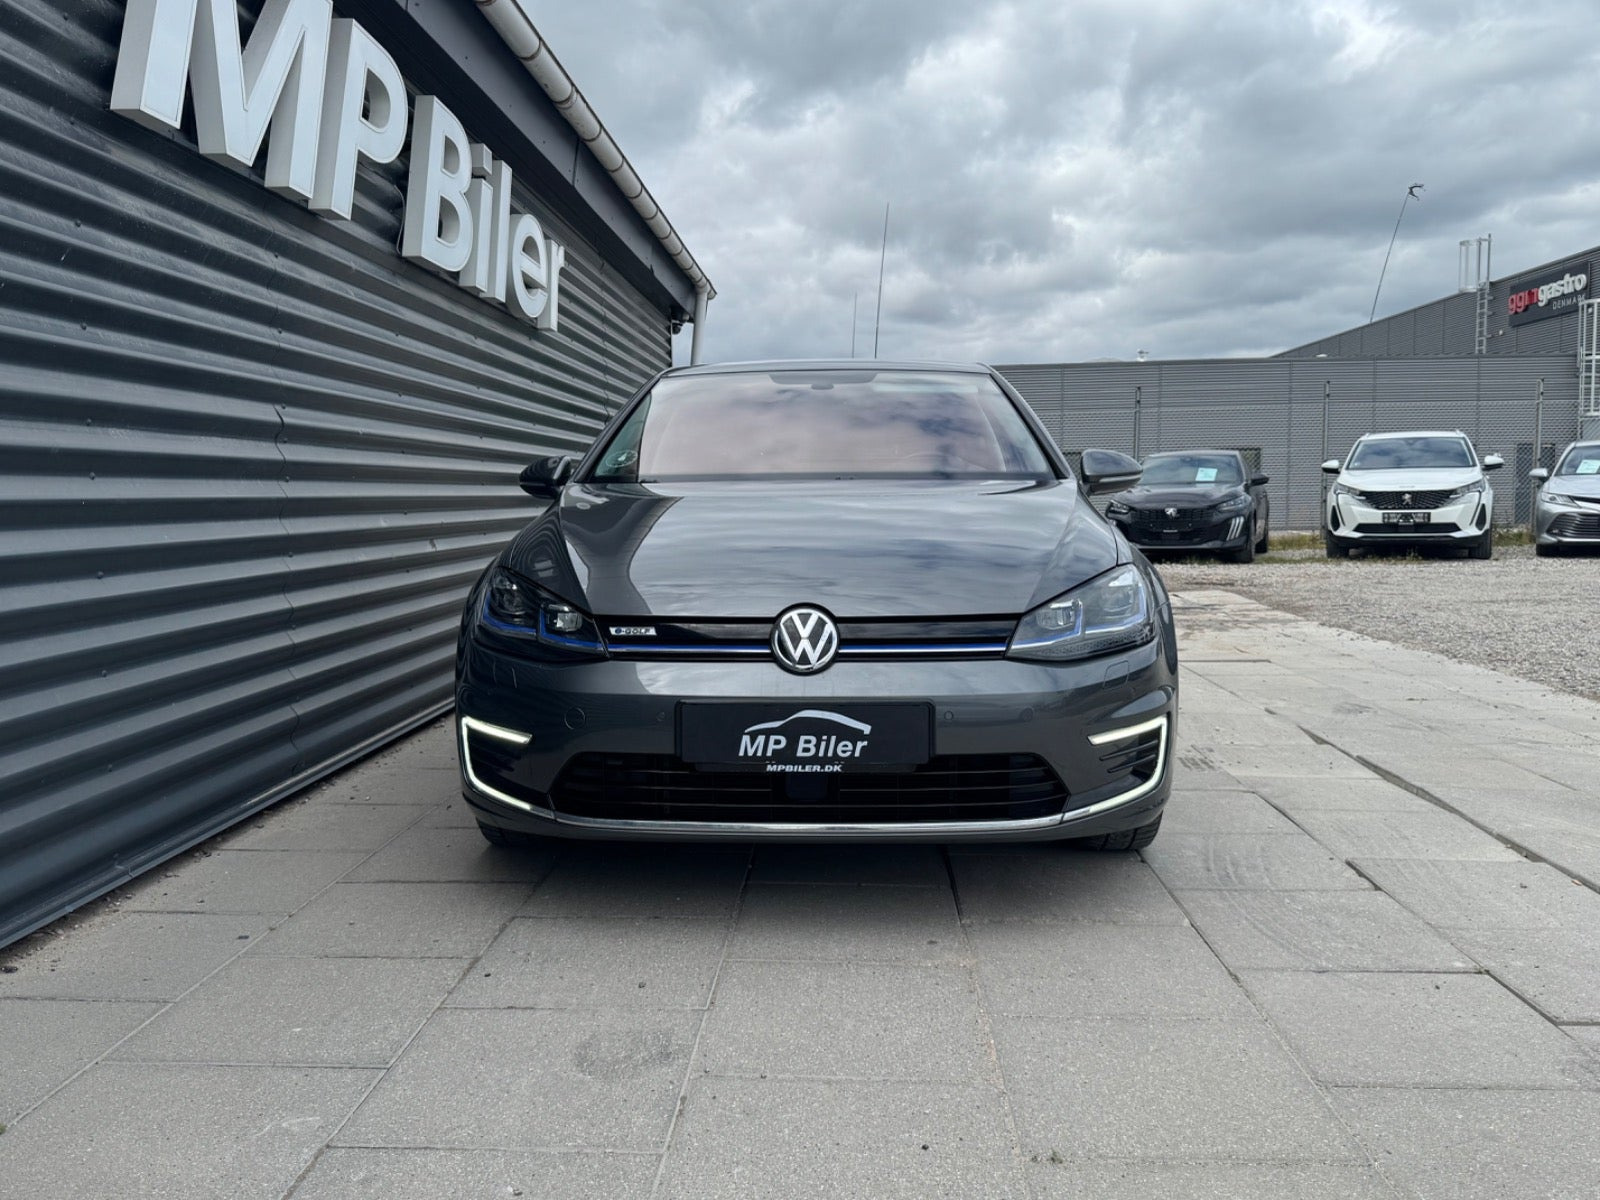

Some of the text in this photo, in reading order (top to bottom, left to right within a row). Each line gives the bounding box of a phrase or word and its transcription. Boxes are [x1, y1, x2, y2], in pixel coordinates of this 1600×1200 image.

[401, 95, 565, 332] Biler
[738, 734, 868, 757] MP Biler
[766, 764, 842, 772] MPBILER.DK
